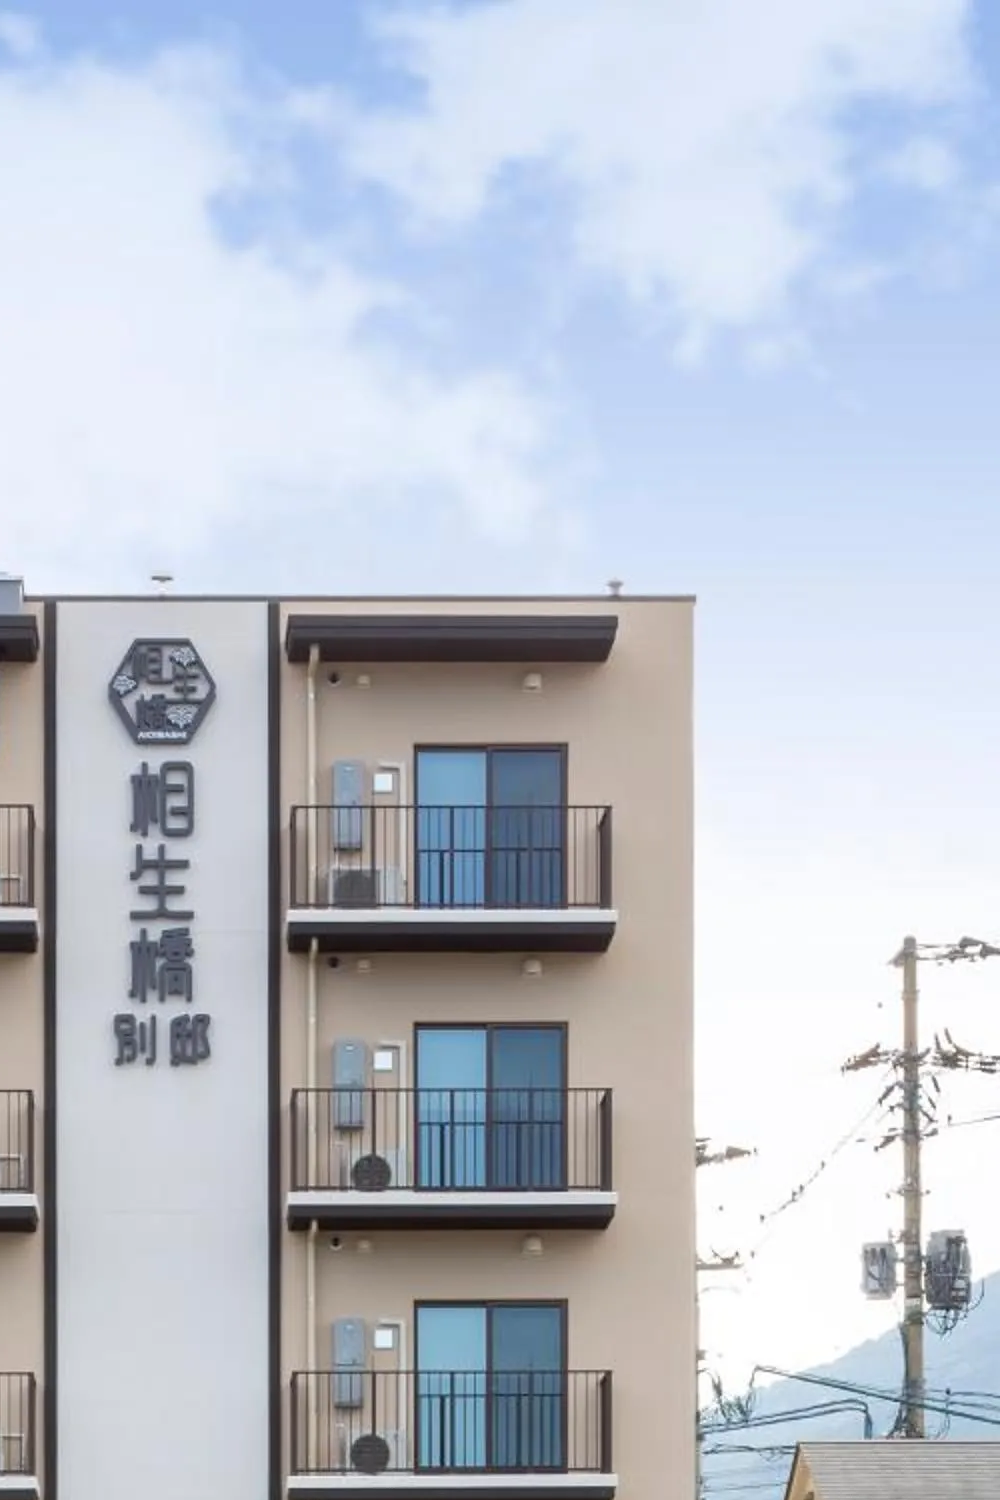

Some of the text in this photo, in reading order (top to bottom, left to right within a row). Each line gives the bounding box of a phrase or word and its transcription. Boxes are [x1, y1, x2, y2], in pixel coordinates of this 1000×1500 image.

[129, 761, 195, 1003] 相生橋
[113, 1013, 211, 1067] 別邸
